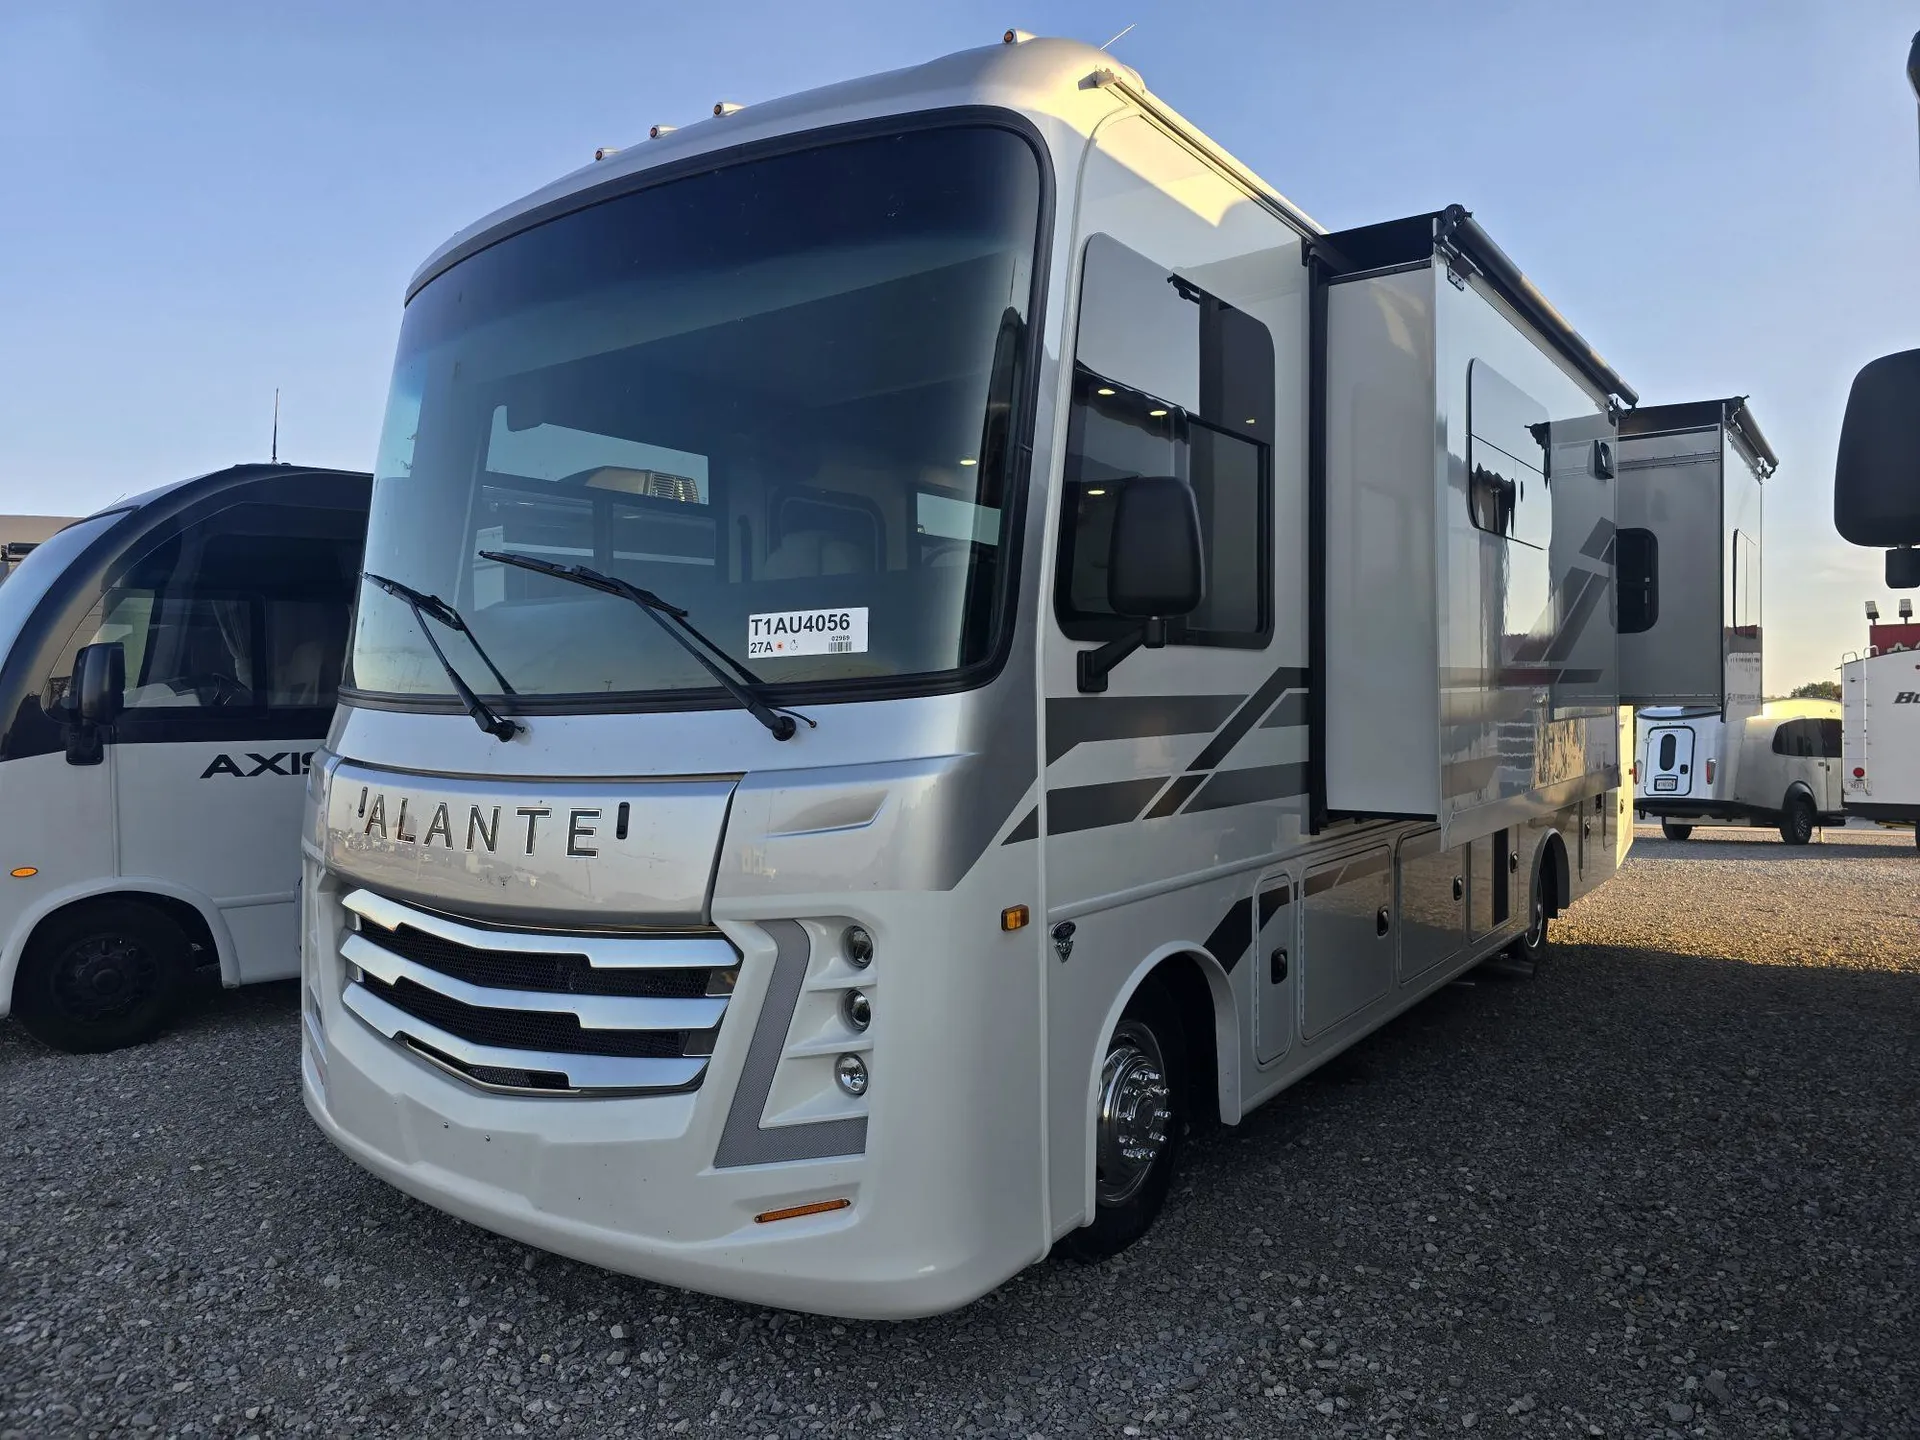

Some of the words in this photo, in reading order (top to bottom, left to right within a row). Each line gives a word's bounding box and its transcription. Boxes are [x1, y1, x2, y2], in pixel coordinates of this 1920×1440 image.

[751, 613, 850, 636] T1AU4056
[750, 641, 773, 654] 27A
[364, 793, 602, 858] ALANTE
